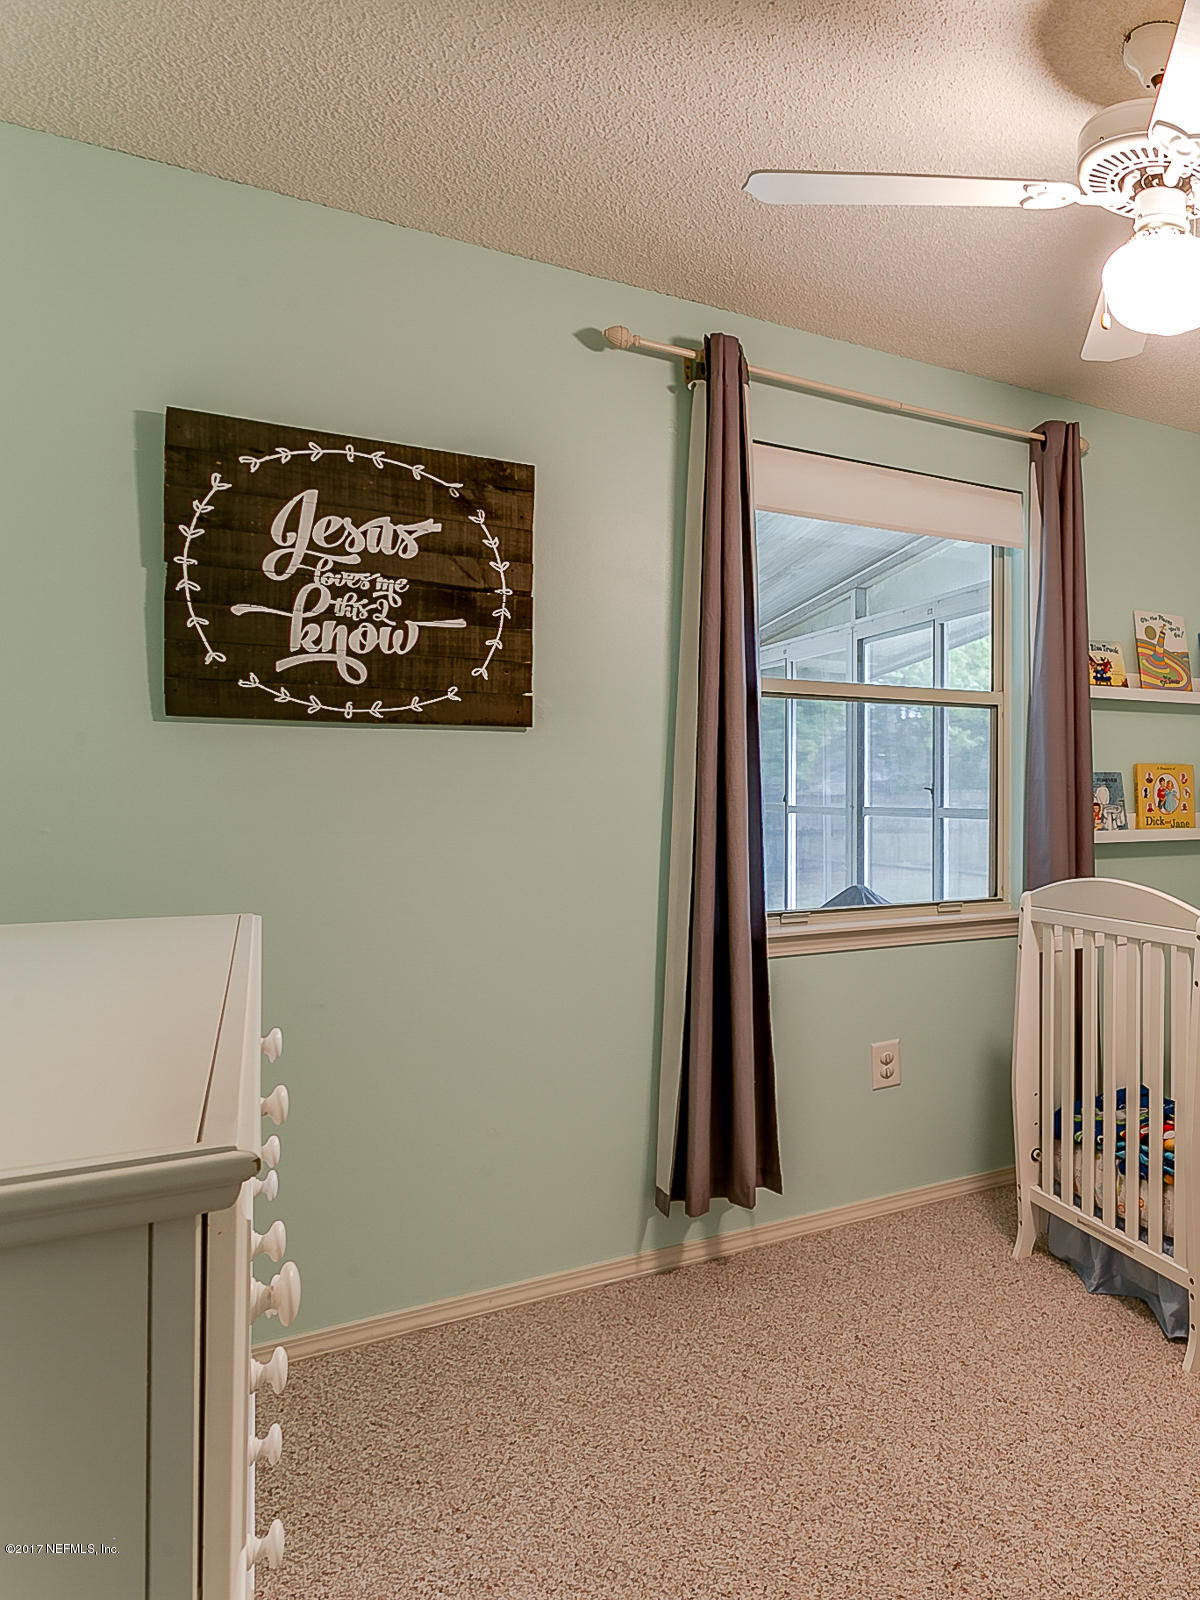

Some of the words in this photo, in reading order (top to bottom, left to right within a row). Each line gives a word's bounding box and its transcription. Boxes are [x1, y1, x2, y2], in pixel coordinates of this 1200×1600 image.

[262, 489, 442, 581] Jesus
[314, 557, 381, 590] loves
[372, 576, 410, 608] me
[331, 592, 370, 621] this
[230, 582, 467, 685] know
[1145, 815, 1165, 826] Dick
[1171, 819, 1190, 828] Jane
